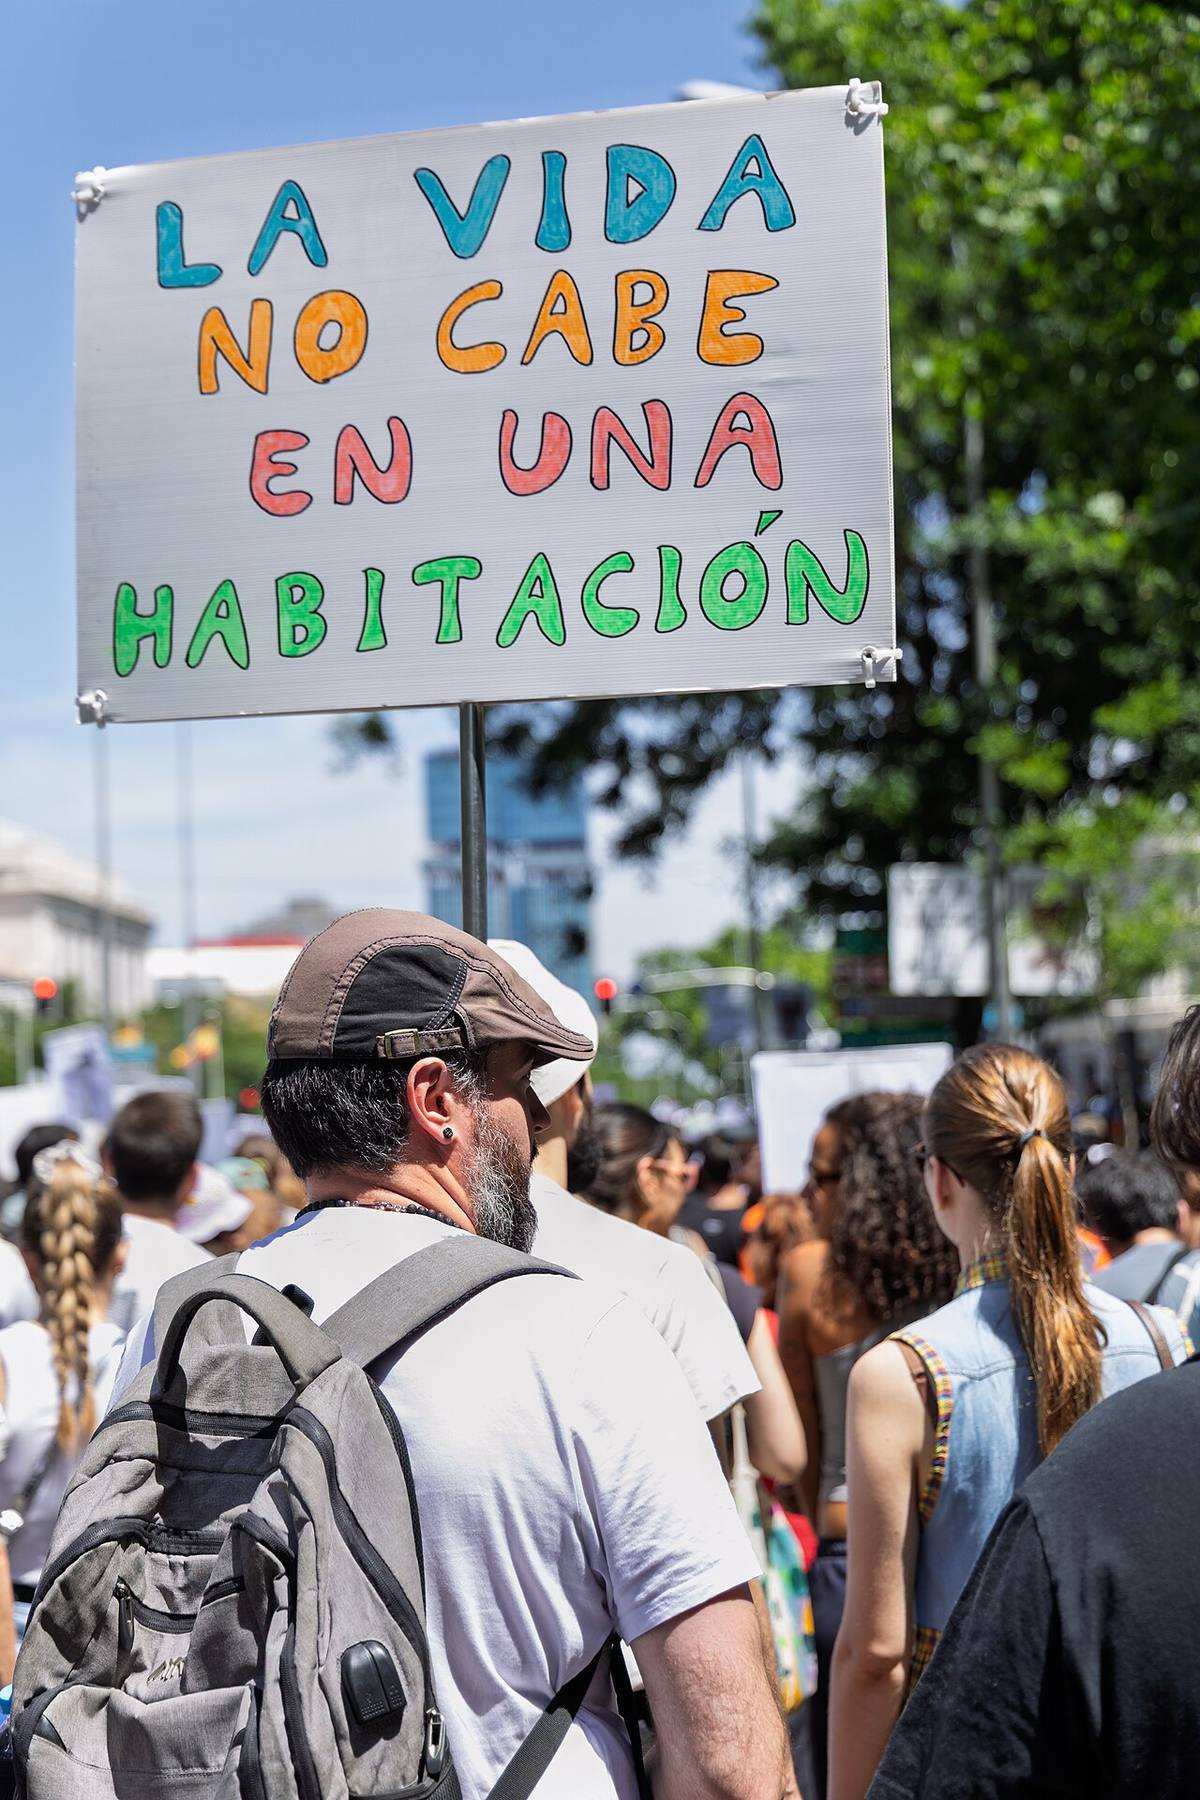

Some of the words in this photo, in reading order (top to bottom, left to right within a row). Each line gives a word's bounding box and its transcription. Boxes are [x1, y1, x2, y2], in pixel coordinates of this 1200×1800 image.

[156, 180, 329, 289] LA
[414, 133, 797, 259] VIDA
[197, 288, 369, 395] NO
[436, 269, 780, 374] CABE
[249, 415, 413, 517] EN
[499, 392, 784, 496] UNA
[112, 509, 870, 677] HABITACIÓN
